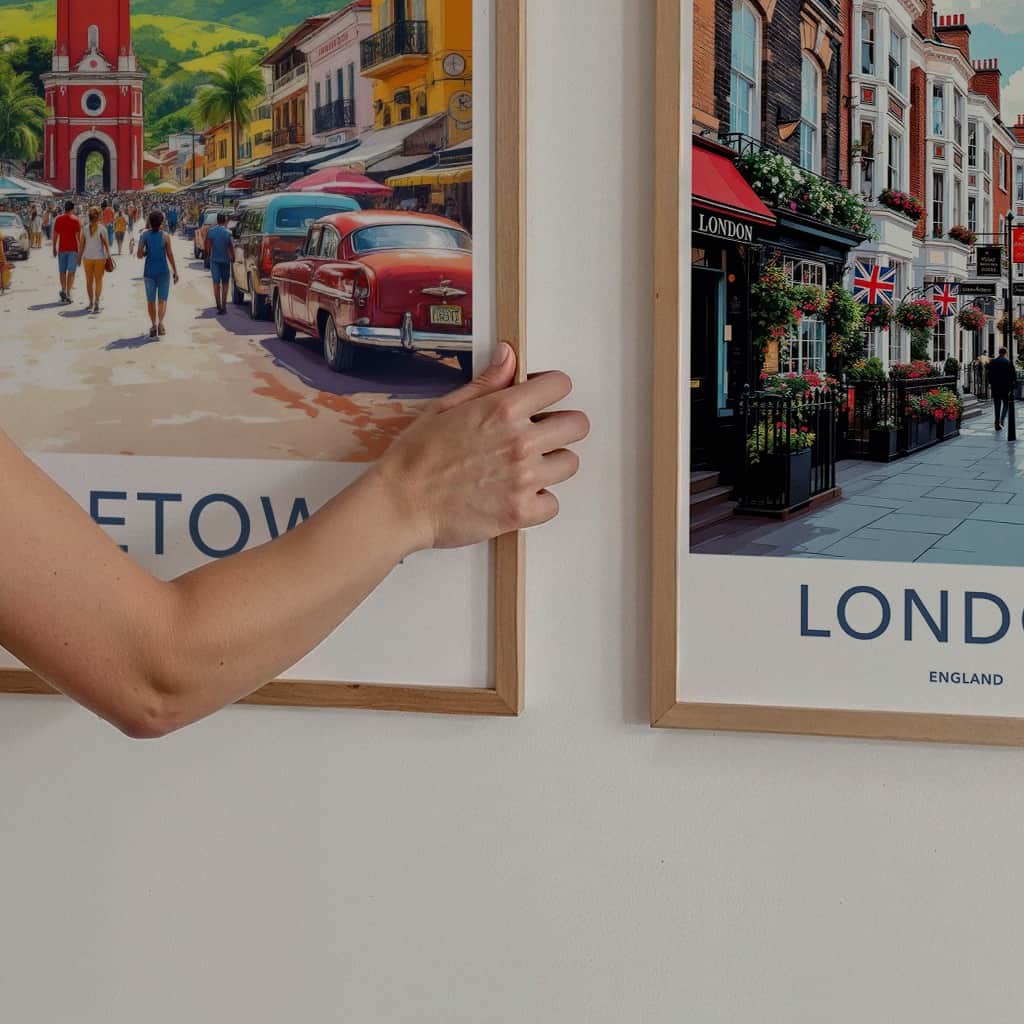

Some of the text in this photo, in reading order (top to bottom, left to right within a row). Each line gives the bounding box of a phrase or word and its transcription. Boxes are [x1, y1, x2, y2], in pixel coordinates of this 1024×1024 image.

[698, 213, 753, 242] LONDON
[800, 584, 1024, 645] LOND
[928, 671, 1004, 686] ENGLAND
